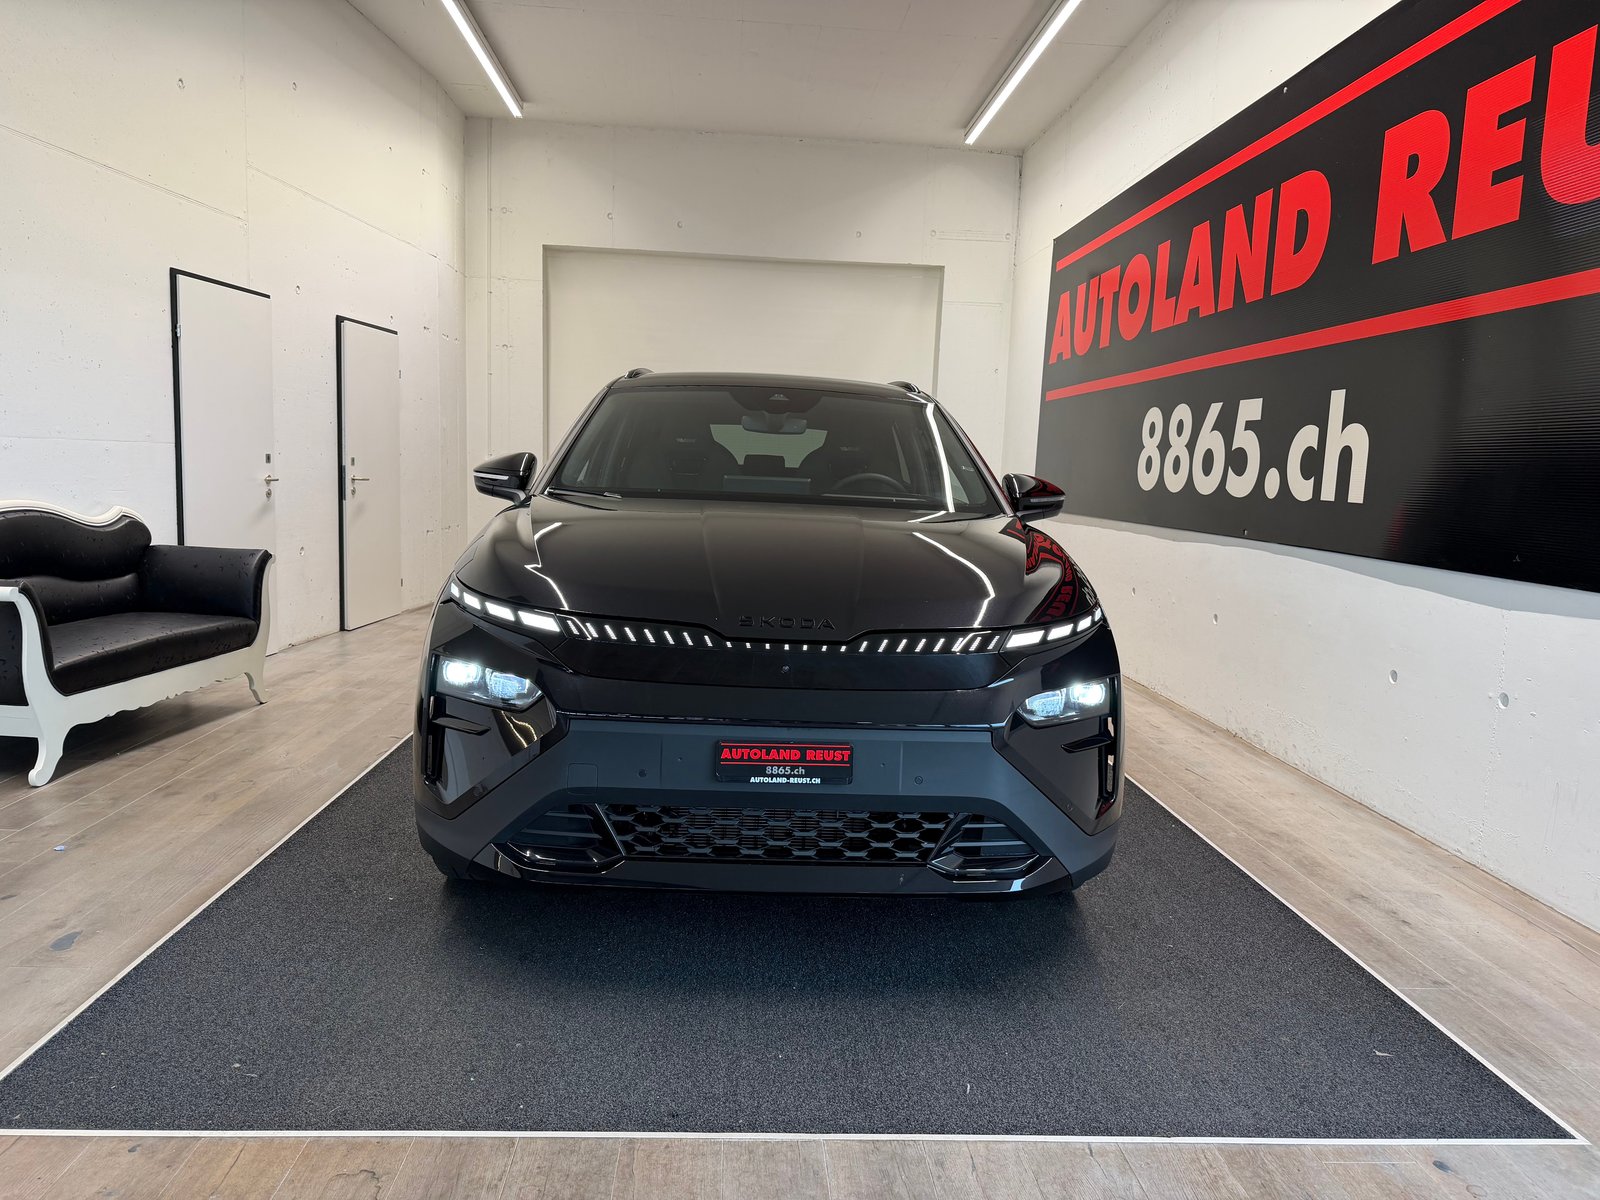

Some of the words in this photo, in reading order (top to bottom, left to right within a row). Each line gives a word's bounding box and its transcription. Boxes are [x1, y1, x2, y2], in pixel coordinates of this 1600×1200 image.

[1049, 170, 1332, 364] AUTOLAND
[1137, 388, 1370, 504] 8865.ch
[720, 748, 801, 761] AUTOLAND
[805, 750, 851, 762] REUST
[765, 765, 805, 775] 8865.ch
[749, 776, 821, 785] AUTOLAND-REUST.CH
